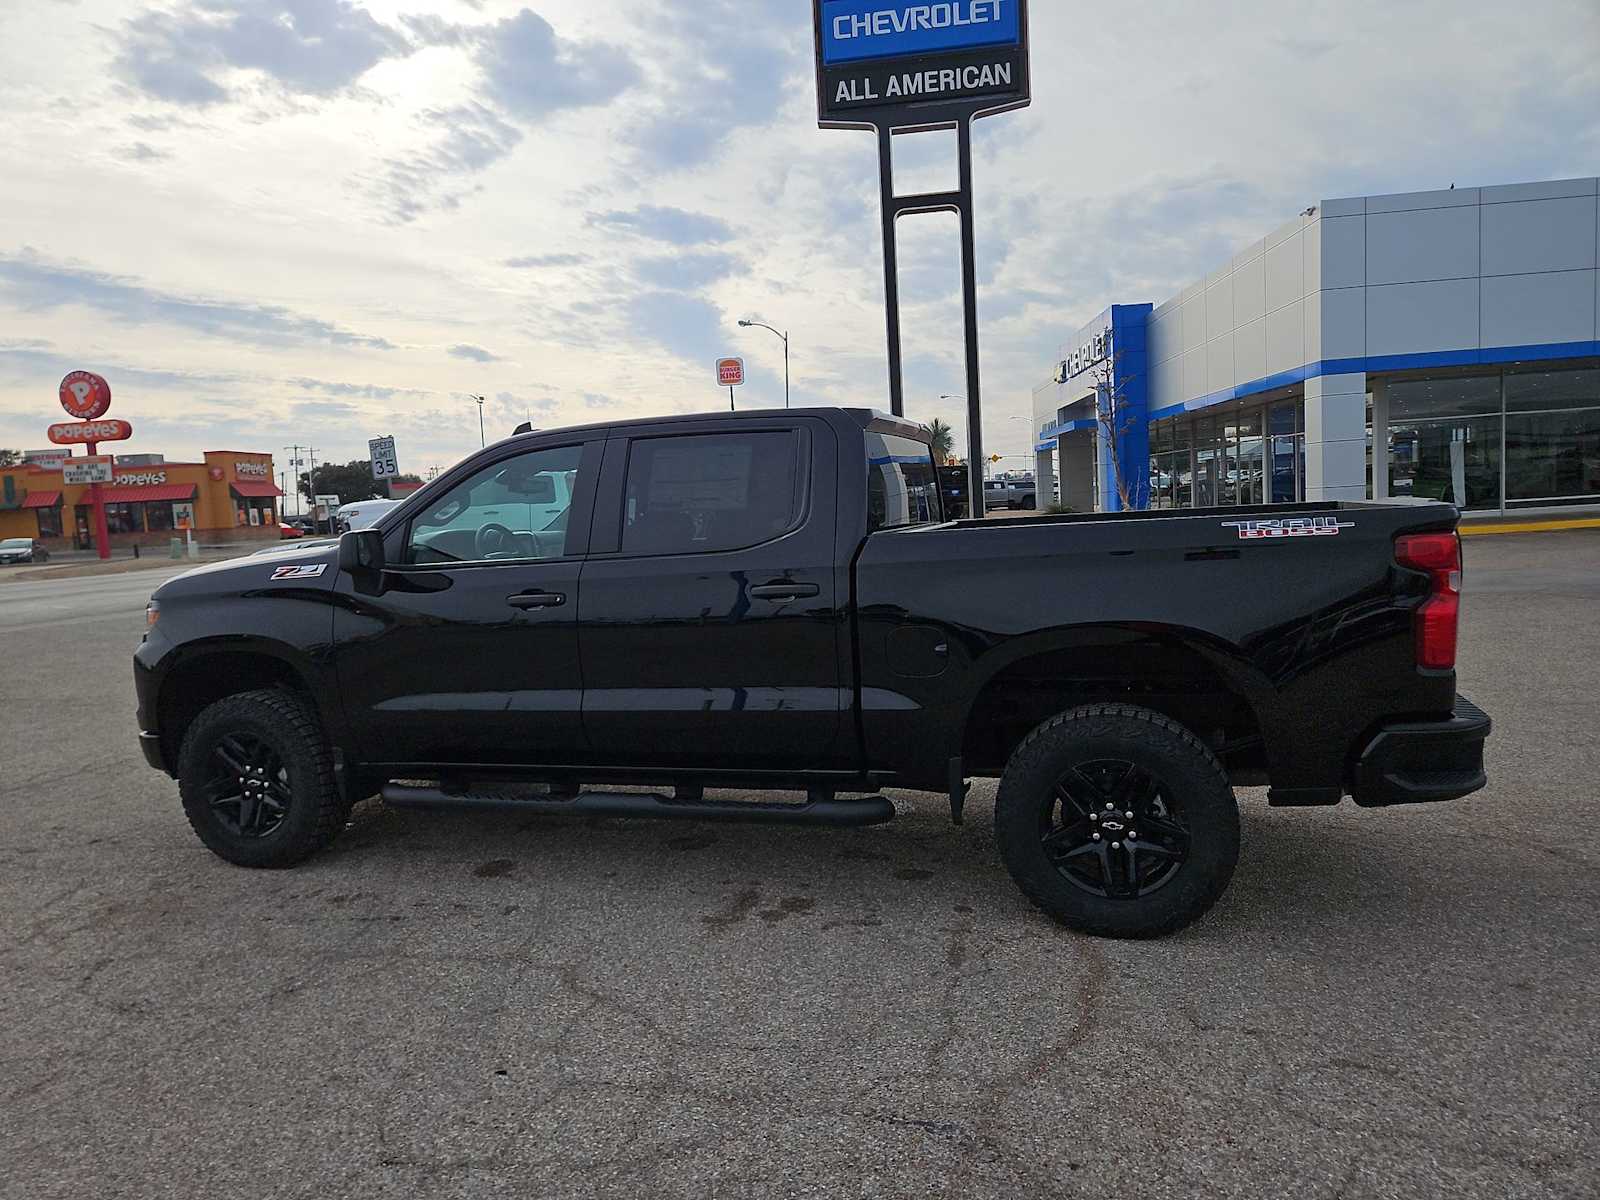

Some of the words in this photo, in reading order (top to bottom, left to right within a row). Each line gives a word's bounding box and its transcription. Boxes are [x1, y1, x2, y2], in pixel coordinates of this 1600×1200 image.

[833, 0, 1004, 40] CHEVROLET
[835, 77, 879, 102] ALL
[885, 62, 1012, 97] AMERICAN
[720, 371, 741, 379] KING
[53, 420, 119, 439] POPEYES
[369, 440, 394, 451] SPEED
[374, 449, 394, 460] LIMIT
[375, 459, 396, 475] 35
[113, 471, 166, 486] POPEYES
[1238, 526, 1341, 540] BOSS
